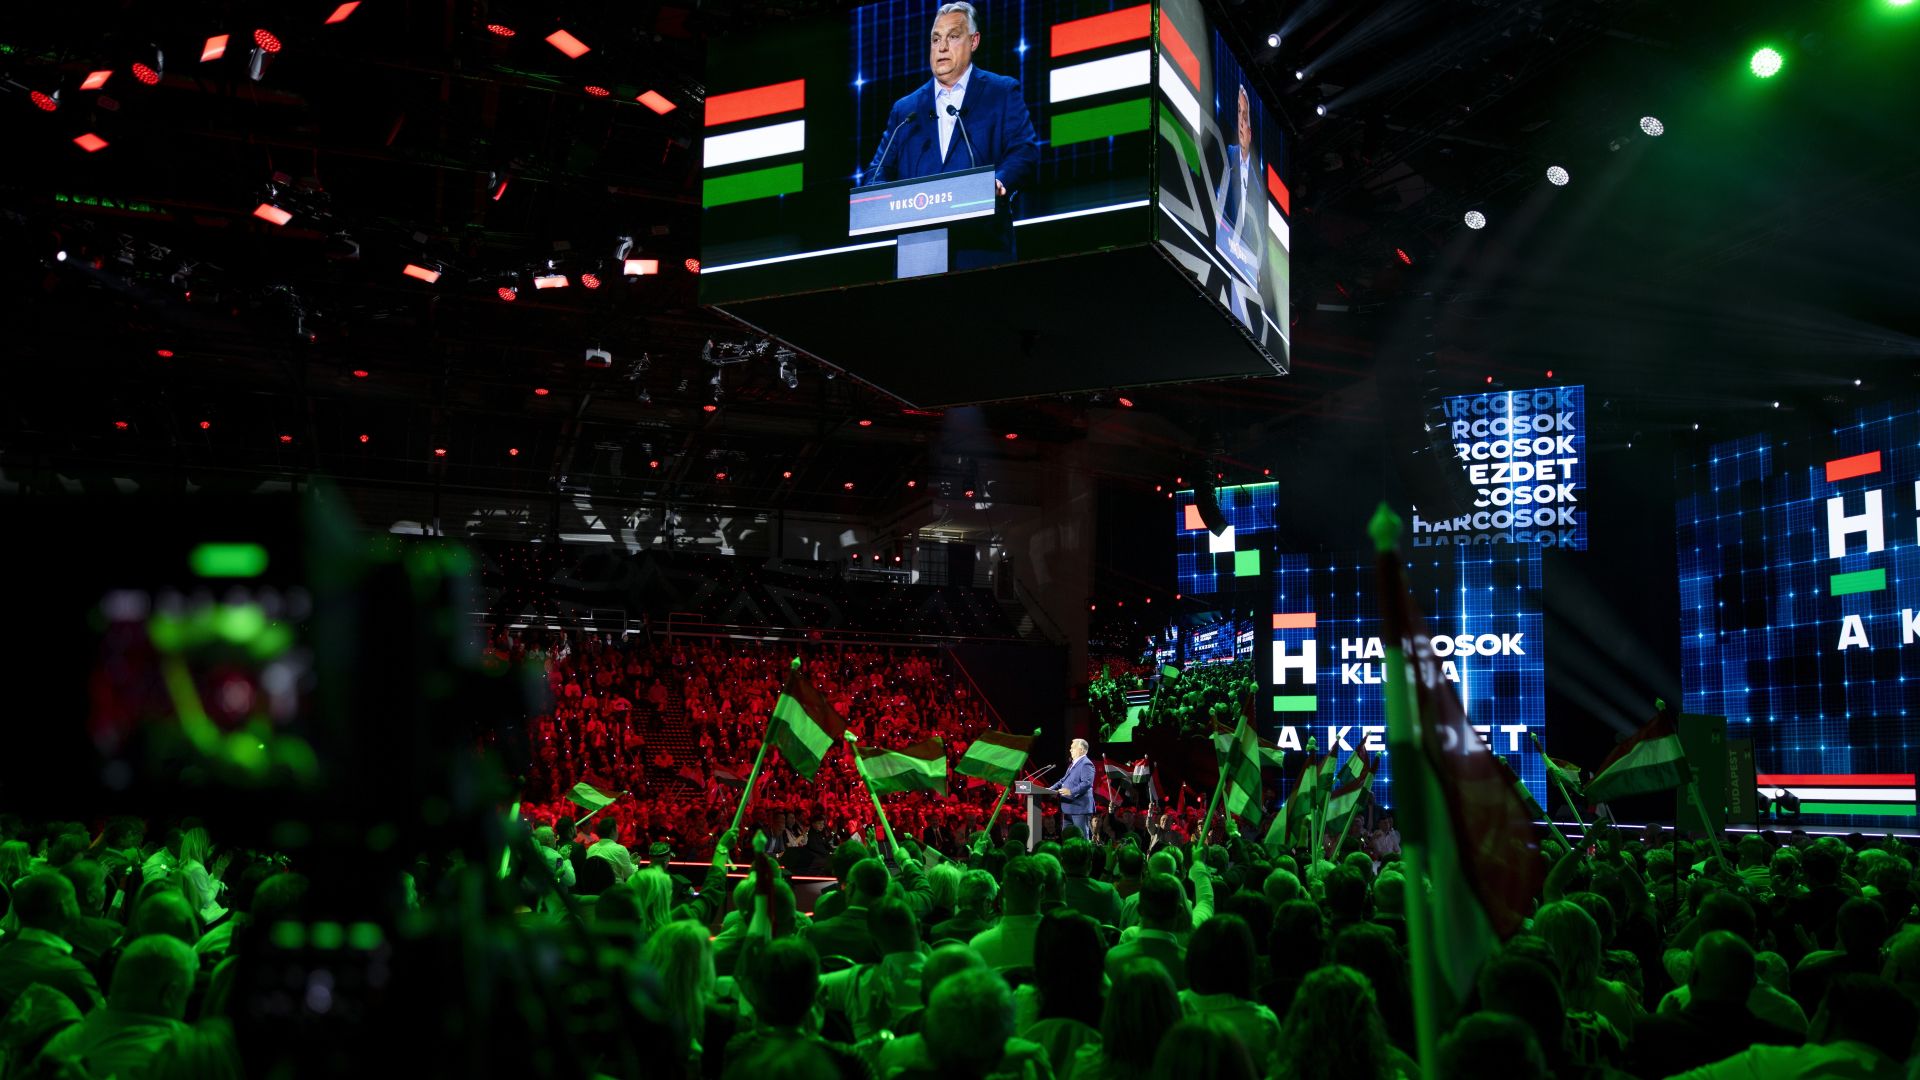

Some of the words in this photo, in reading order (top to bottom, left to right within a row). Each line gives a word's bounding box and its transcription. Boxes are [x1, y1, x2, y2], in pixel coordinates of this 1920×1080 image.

[890, 198, 914, 211] VOKS
[929, 192, 953, 205] 2025
[1452, 412, 1576, 439] RCOSOK
[1455, 435, 1577, 461] RCOSOK
[1463, 458, 1578, 485] EZDET
[1474, 483, 1578, 507] COSOK
[1827, 489, 1885, 559] H
[1838, 614, 1870, 650] A
[1273, 640, 1317, 684] H
[1277, 726, 1303, 751] A
[1327, 725, 1527, 752] KEDET
[1729, 750, 1742, 814] BUDAPEST
